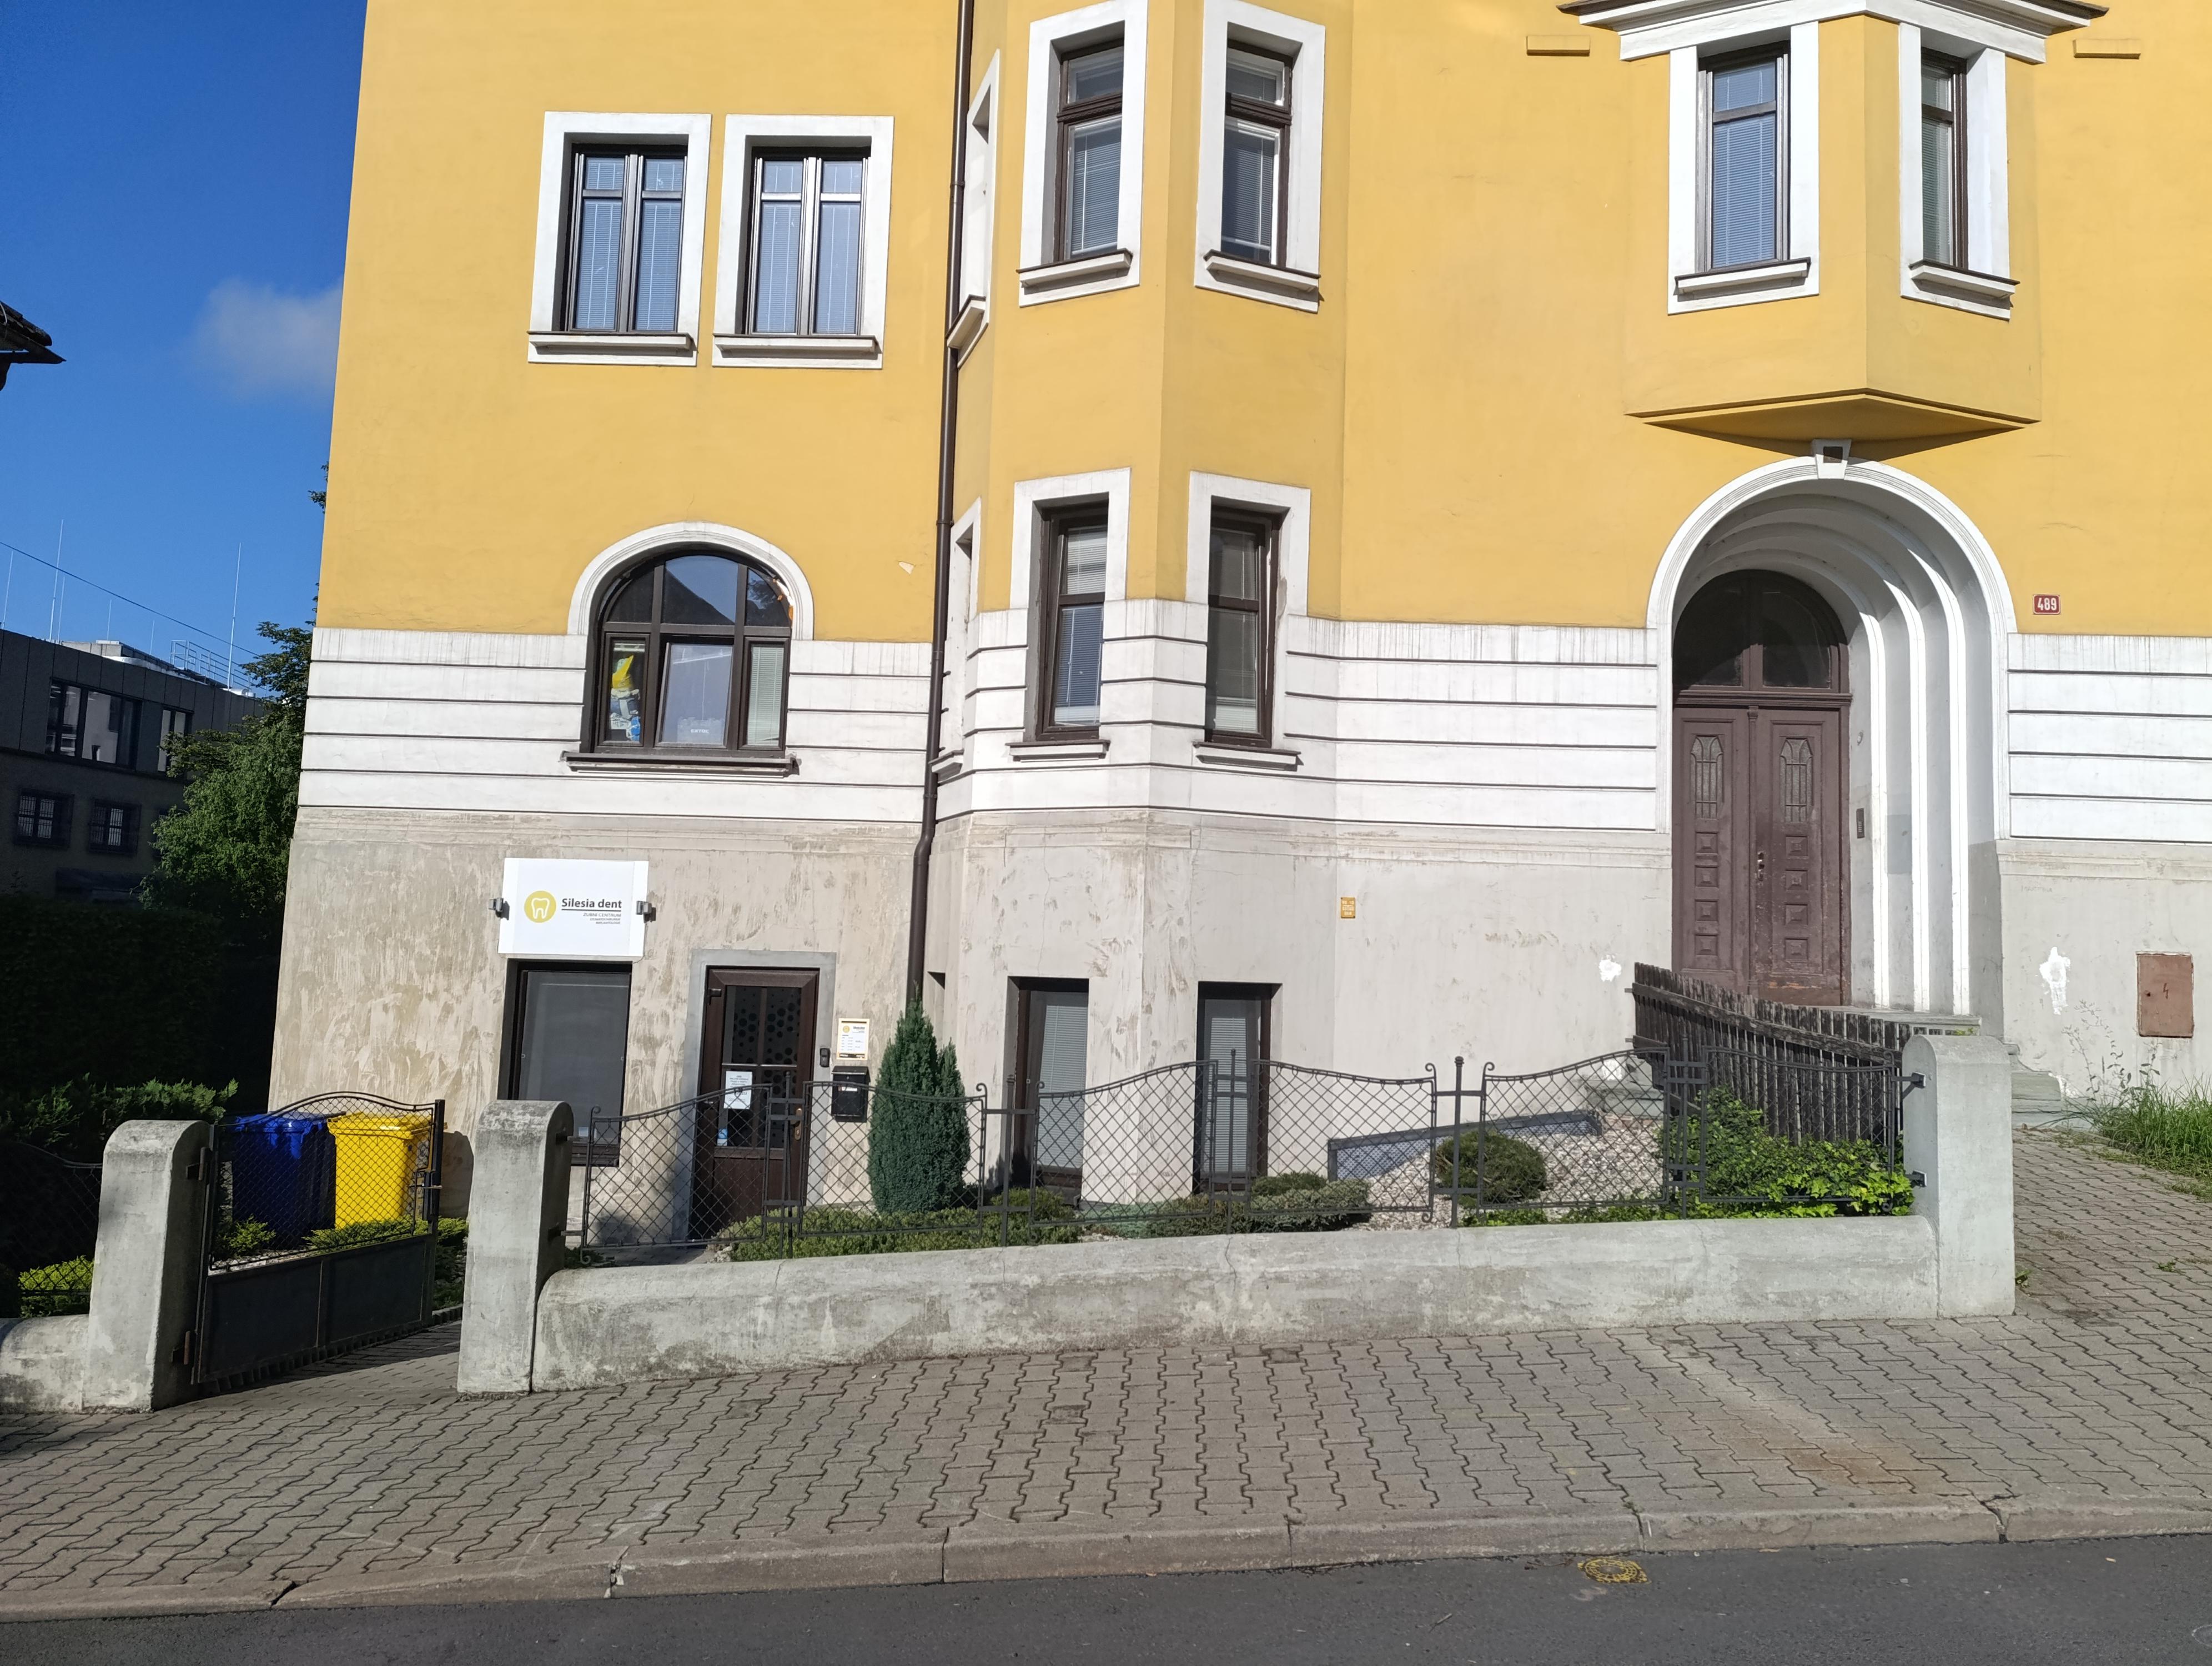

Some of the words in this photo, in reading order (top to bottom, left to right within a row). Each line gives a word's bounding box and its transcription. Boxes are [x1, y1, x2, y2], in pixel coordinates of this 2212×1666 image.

[2037, 598, 2057, 611] 489
[561, 898, 595, 907] Silesia
[598, 899, 622, 909] dent
